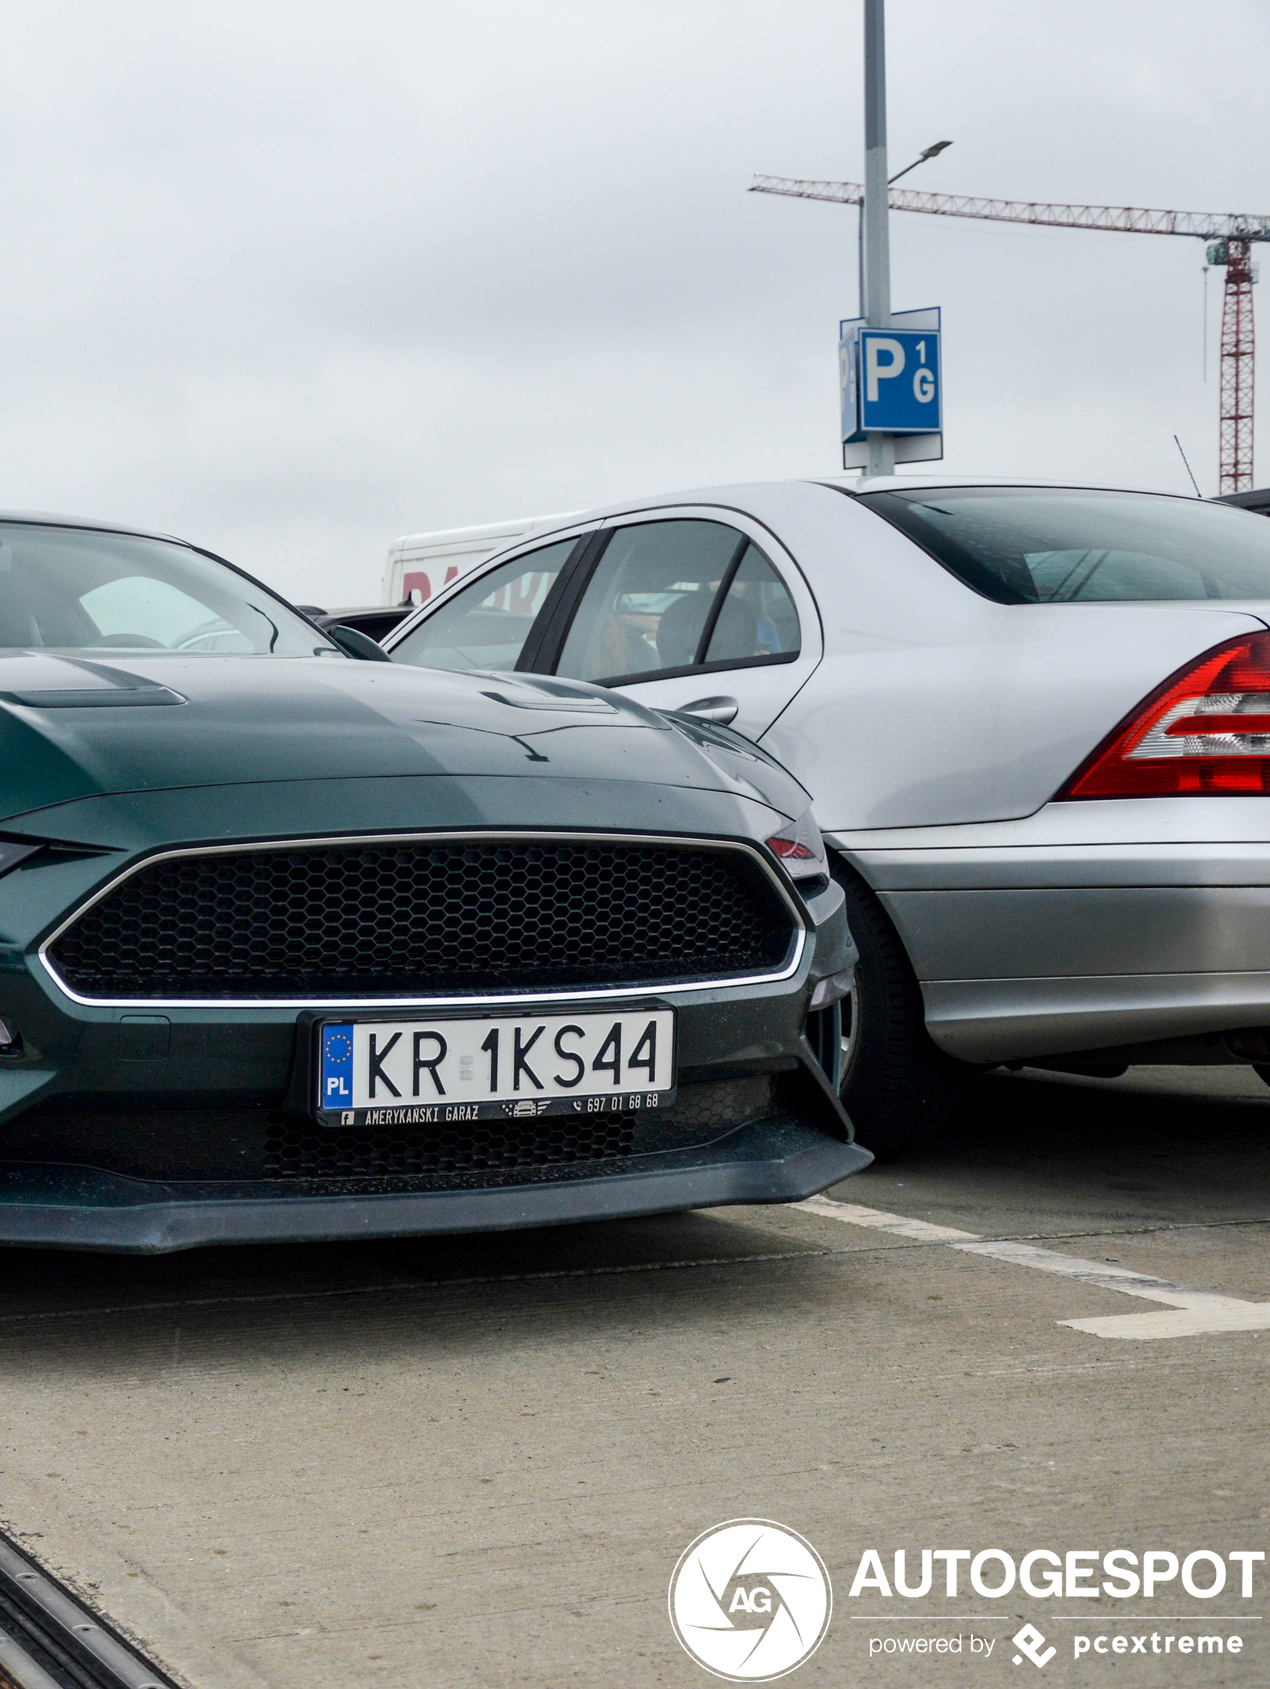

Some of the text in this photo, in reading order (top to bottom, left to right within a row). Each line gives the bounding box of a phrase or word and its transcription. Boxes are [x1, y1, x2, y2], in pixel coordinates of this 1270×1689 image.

[916, 340, 926, 364] 1
[866, 337, 906, 401] P
[913, 368, 935, 403] G
[368, 1020, 658, 1099] KR 1KS44
[327, 1077, 349, 1096] PL
[587, 1093, 658, 1112] 697 01 68 68
[365, 1107, 439, 1126] AMERYKAŃSKI
